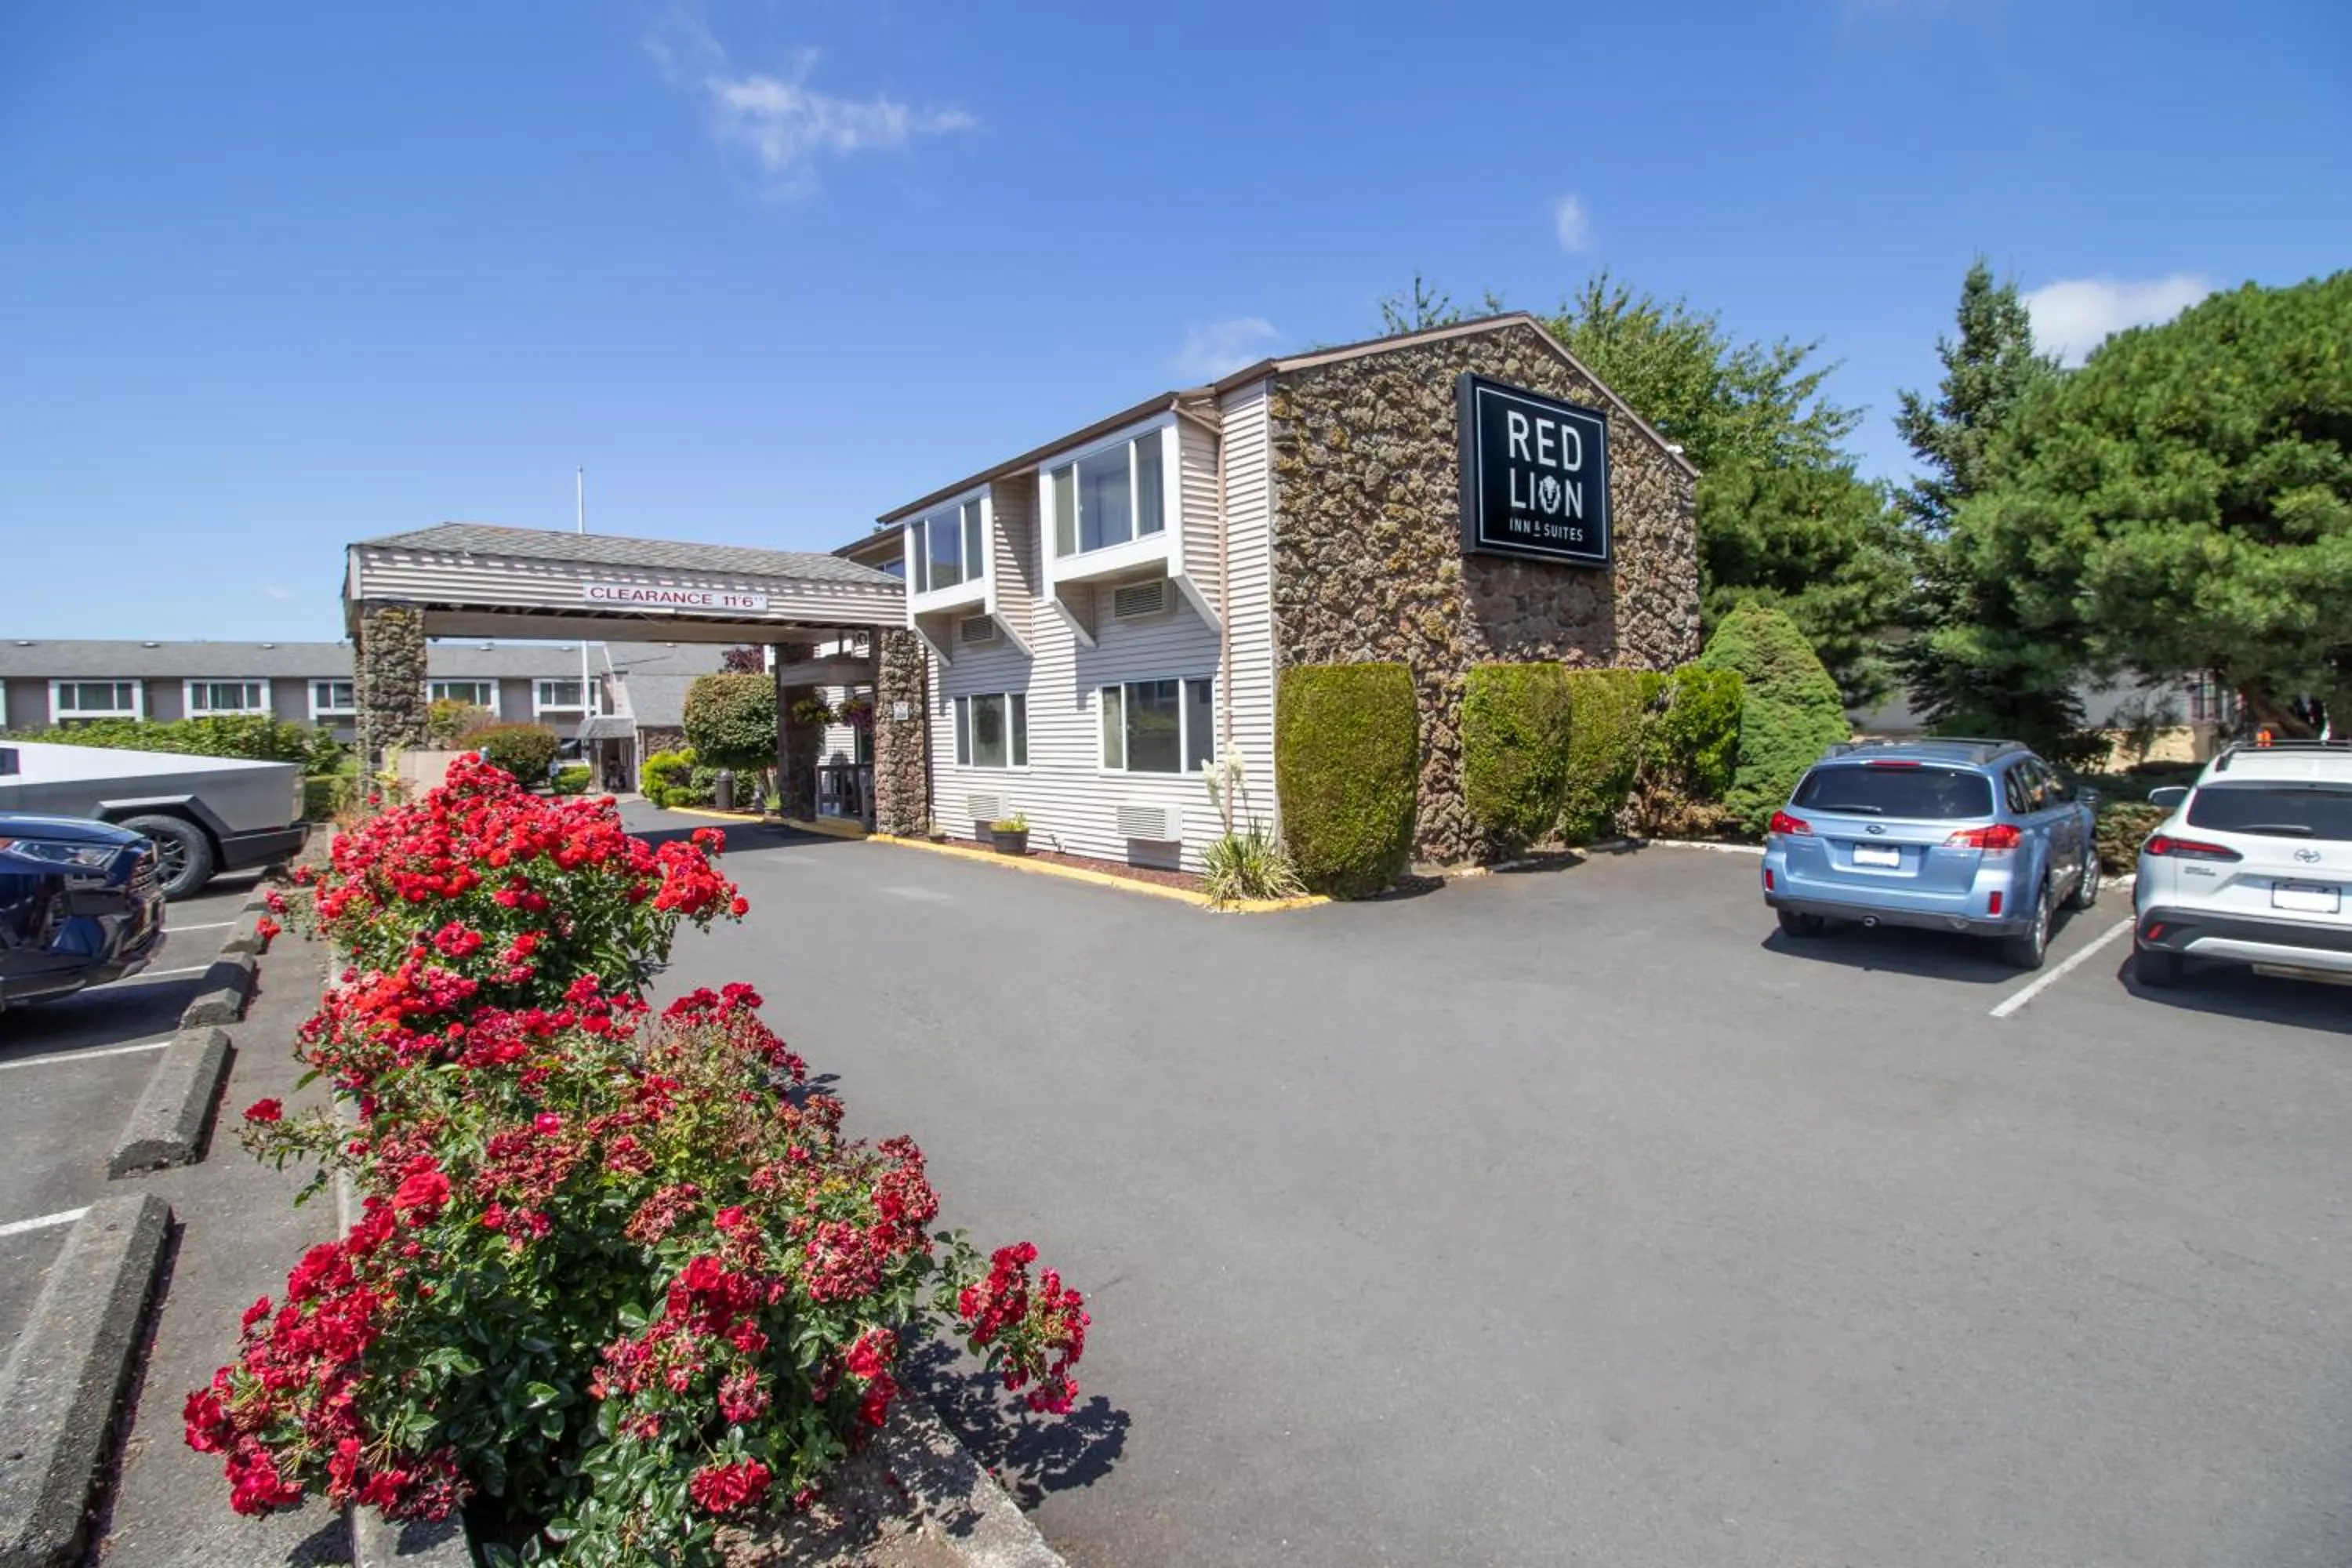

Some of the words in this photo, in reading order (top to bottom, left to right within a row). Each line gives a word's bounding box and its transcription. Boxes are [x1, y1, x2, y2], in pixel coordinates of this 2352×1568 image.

[1507, 409, 1582, 472] RED
[1509, 467, 1583, 520] LION
[1509, 517, 1531, 533] INN
[1544, 523, 1583, 542] SUITES
[590, 587, 713, 605] CLEARANCE
